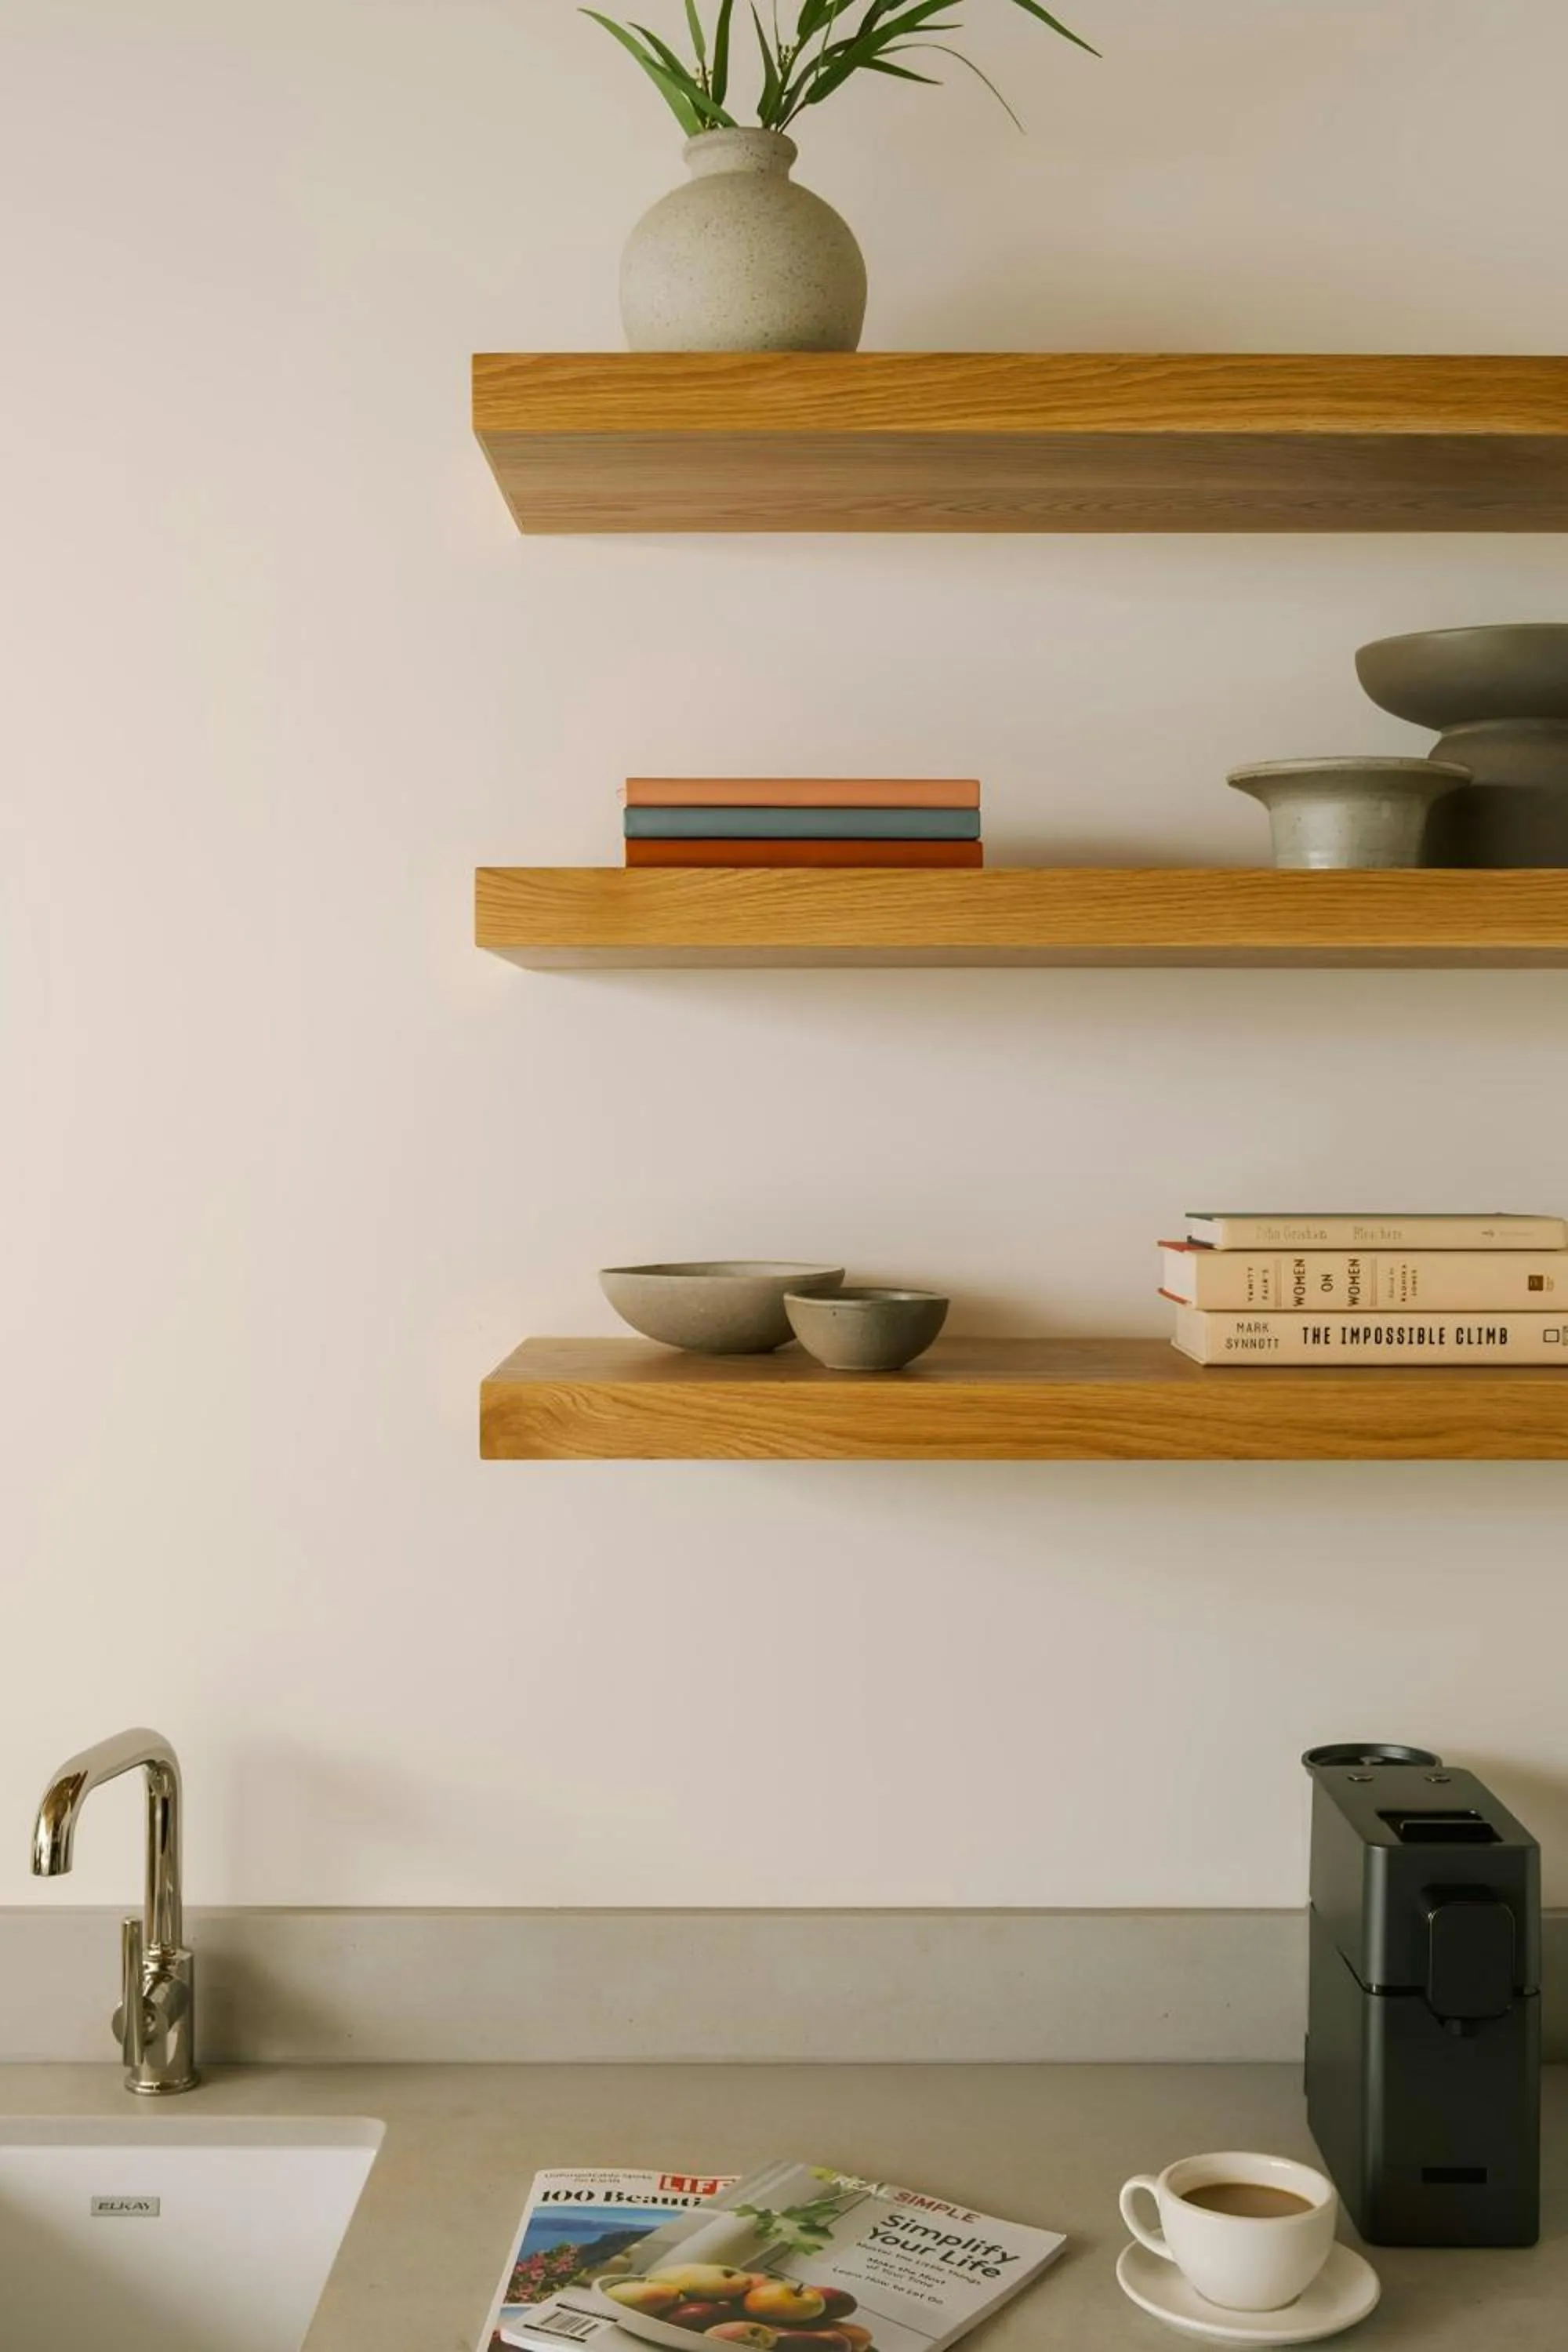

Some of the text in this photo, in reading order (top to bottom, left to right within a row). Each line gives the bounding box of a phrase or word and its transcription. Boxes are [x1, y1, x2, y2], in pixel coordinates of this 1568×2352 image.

[1293, 1258, 1305, 1307] WOMEN
[1320, 1273, 1333, 1293] ON
[1347, 1258, 1360, 1307] WOMEN
[1236, 1322, 1269, 1333] MARK
[1302, 1327, 1508, 1345] THE IMPOSSIBLE CLIMB
[1225, 1338, 1280, 1350] SYNNOTT
[542, 2190, 596, 2203] 100
[893, 2191, 981, 2224] SIMPLE
[868, 2226, 1002, 2278] Your Life
[880, 2213, 1021, 2265] Simplify
